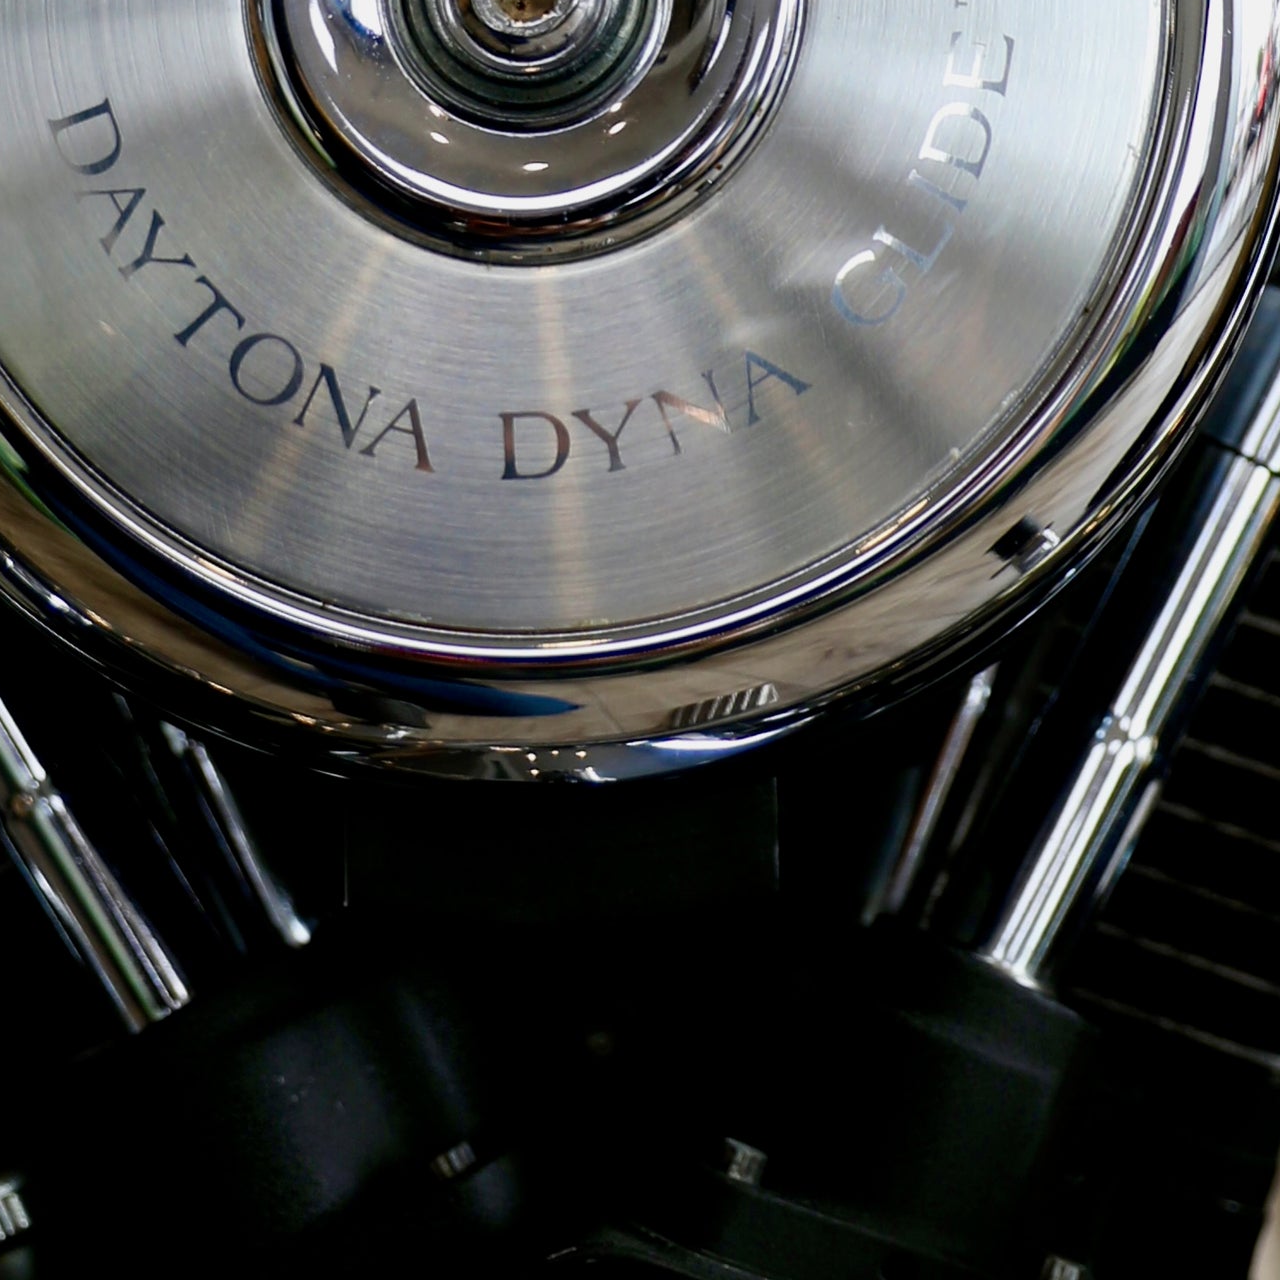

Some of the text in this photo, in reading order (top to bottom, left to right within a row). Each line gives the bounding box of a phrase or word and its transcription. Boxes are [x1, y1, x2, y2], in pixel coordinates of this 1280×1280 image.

[47, 97, 437, 474] DAYTONA
[497, 349, 812, 481] DYNA
[831, 30, 1016, 330] GLIDE
